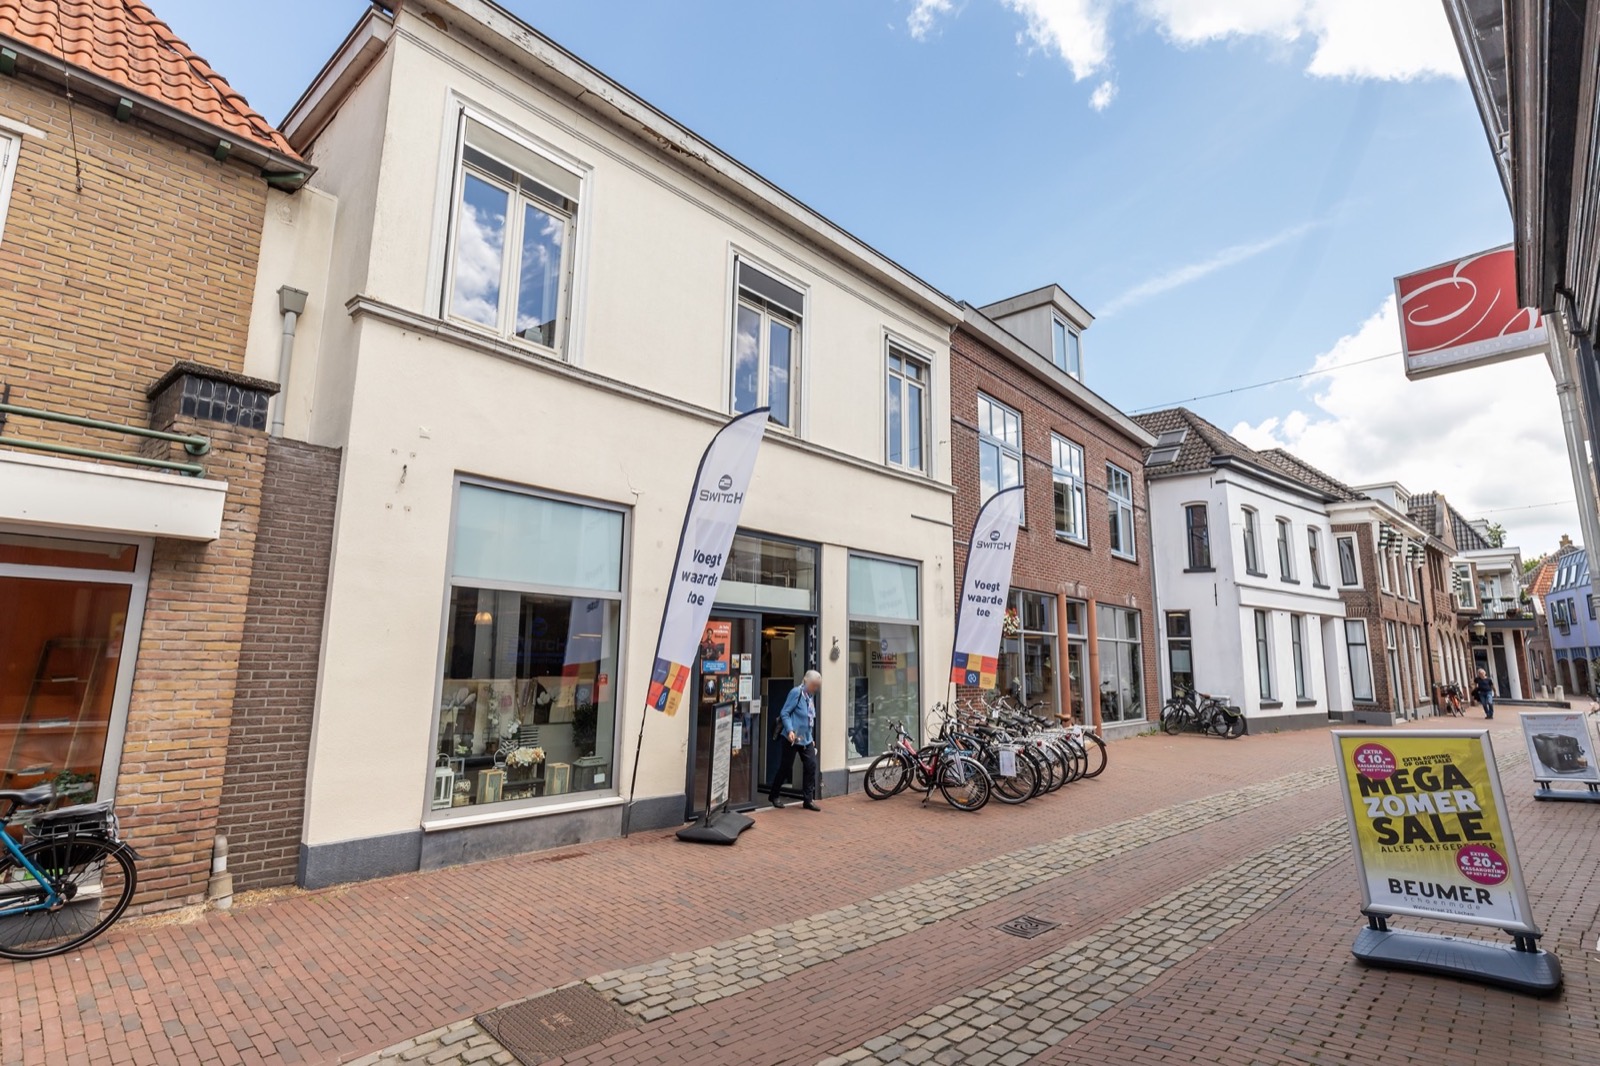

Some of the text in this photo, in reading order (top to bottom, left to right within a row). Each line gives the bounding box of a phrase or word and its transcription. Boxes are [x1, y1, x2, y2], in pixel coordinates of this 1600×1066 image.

[699, 489, 744, 504] SWITCH
[975, 540, 1012, 551] SWITCH
[692, 549, 722, 568] Voegt
[974, 579, 1001, 592] Voegt
[686, 590, 705, 606] toe
[967, 593, 1003, 606] waarde
[976, 607, 991, 618] toe
[871, 650, 898, 661] SWITCH
[1357, 754, 1366, 763] €
[1356, 764, 1473, 797] MEGA
[1363, 789, 1482, 818] ZOMER
[1372, 811, 1493, 846] SALE
[1381, 845, 1412, 853] ALLES
[1414, 844, 1425, 852] IS
[1460, 855, 1470, 866] €
[1388, 878, 1494, 906] BEUMER
[1403, 896, 1481, 910] schoenmode
